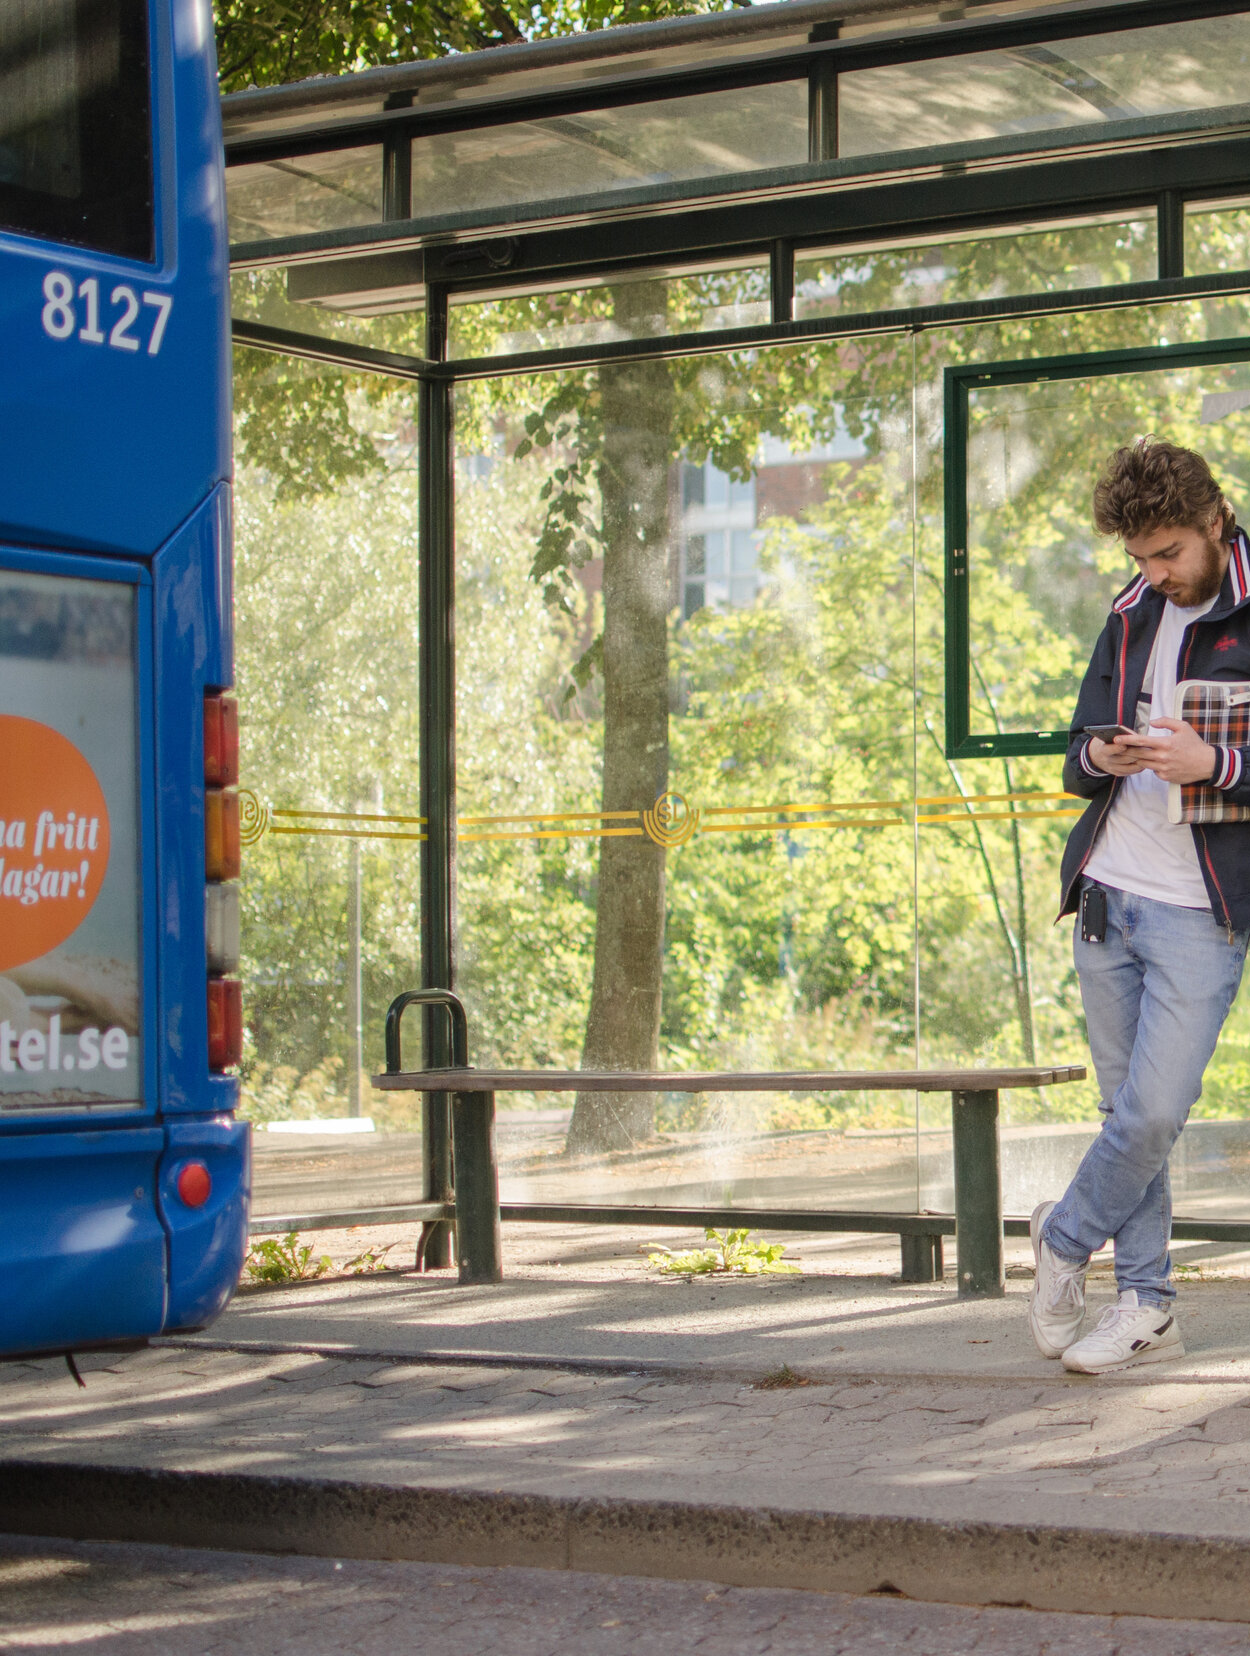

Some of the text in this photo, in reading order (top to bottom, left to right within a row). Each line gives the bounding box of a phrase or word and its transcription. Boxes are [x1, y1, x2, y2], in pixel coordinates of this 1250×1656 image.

[42, 271, 174, 356] 8127
[0, 810, 100, 857] a fritt
[658, 803, 682, 823] SL
[0, 1013, 129, 1073] tel.se
